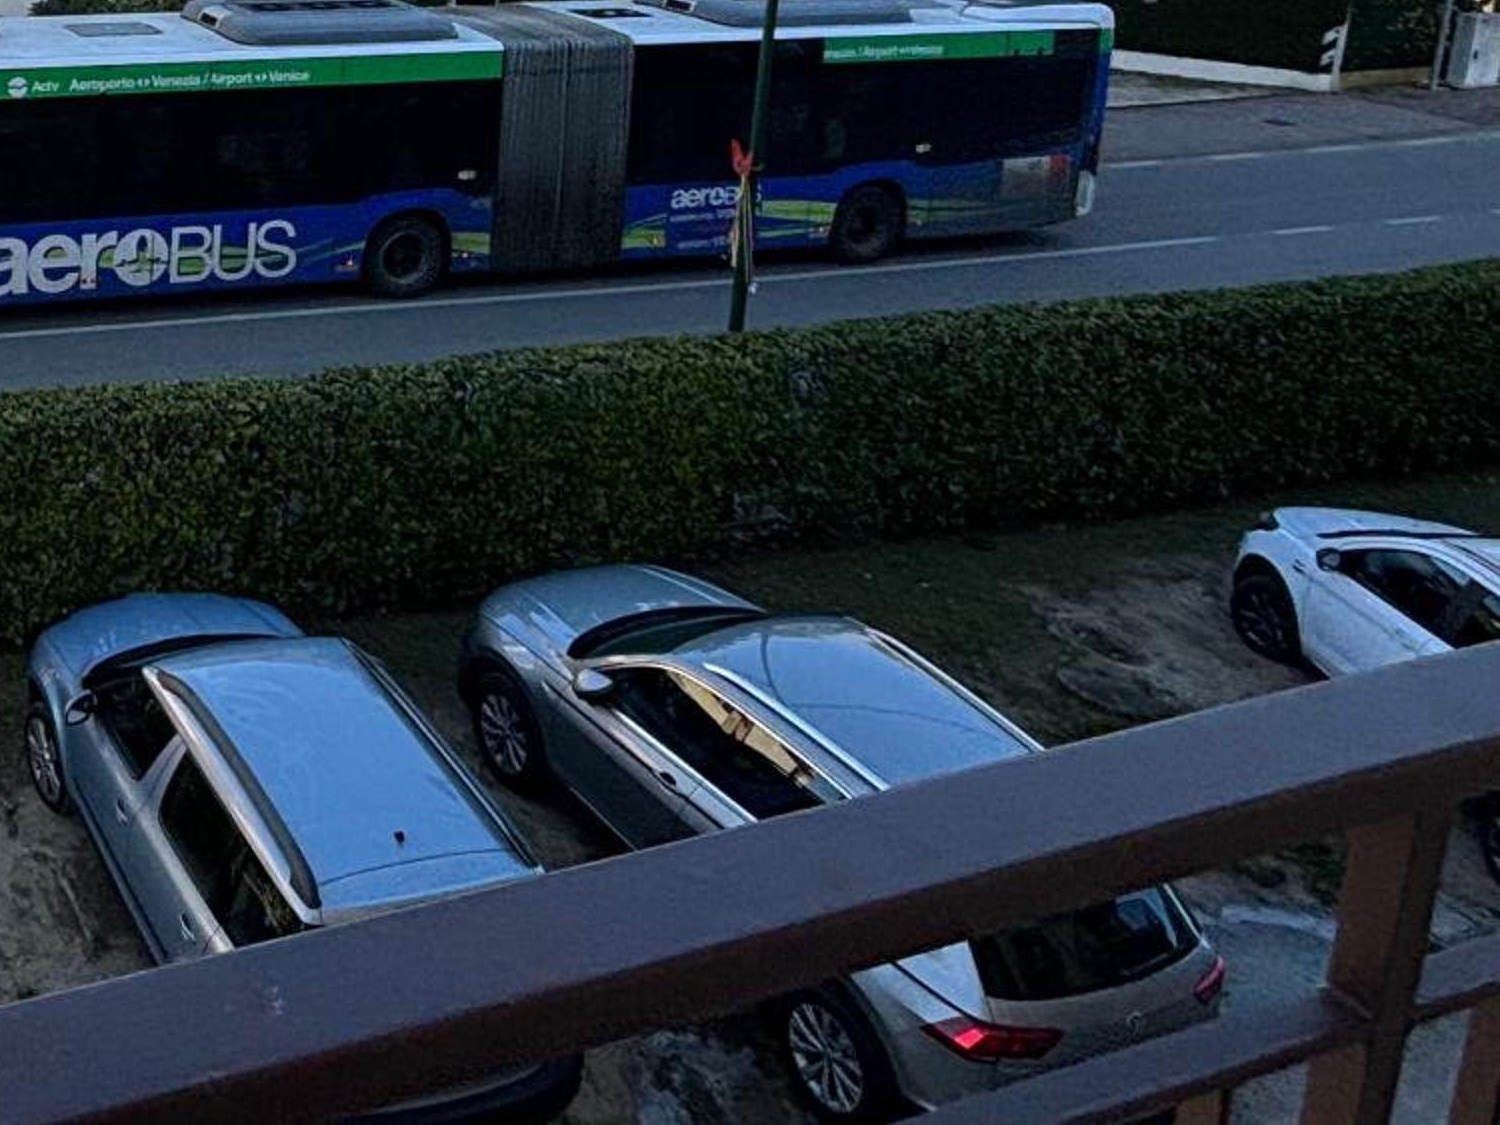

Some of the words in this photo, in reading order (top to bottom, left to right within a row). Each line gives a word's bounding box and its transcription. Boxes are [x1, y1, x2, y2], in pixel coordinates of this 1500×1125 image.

[31, 81, 59, 92] Actv
[69, 77, 134, 93] Aeroporto
[151, 74, 201, 88] Venezia
[210, 72, 253, 87] Airport
[268, 70, 310, 83] Venice
